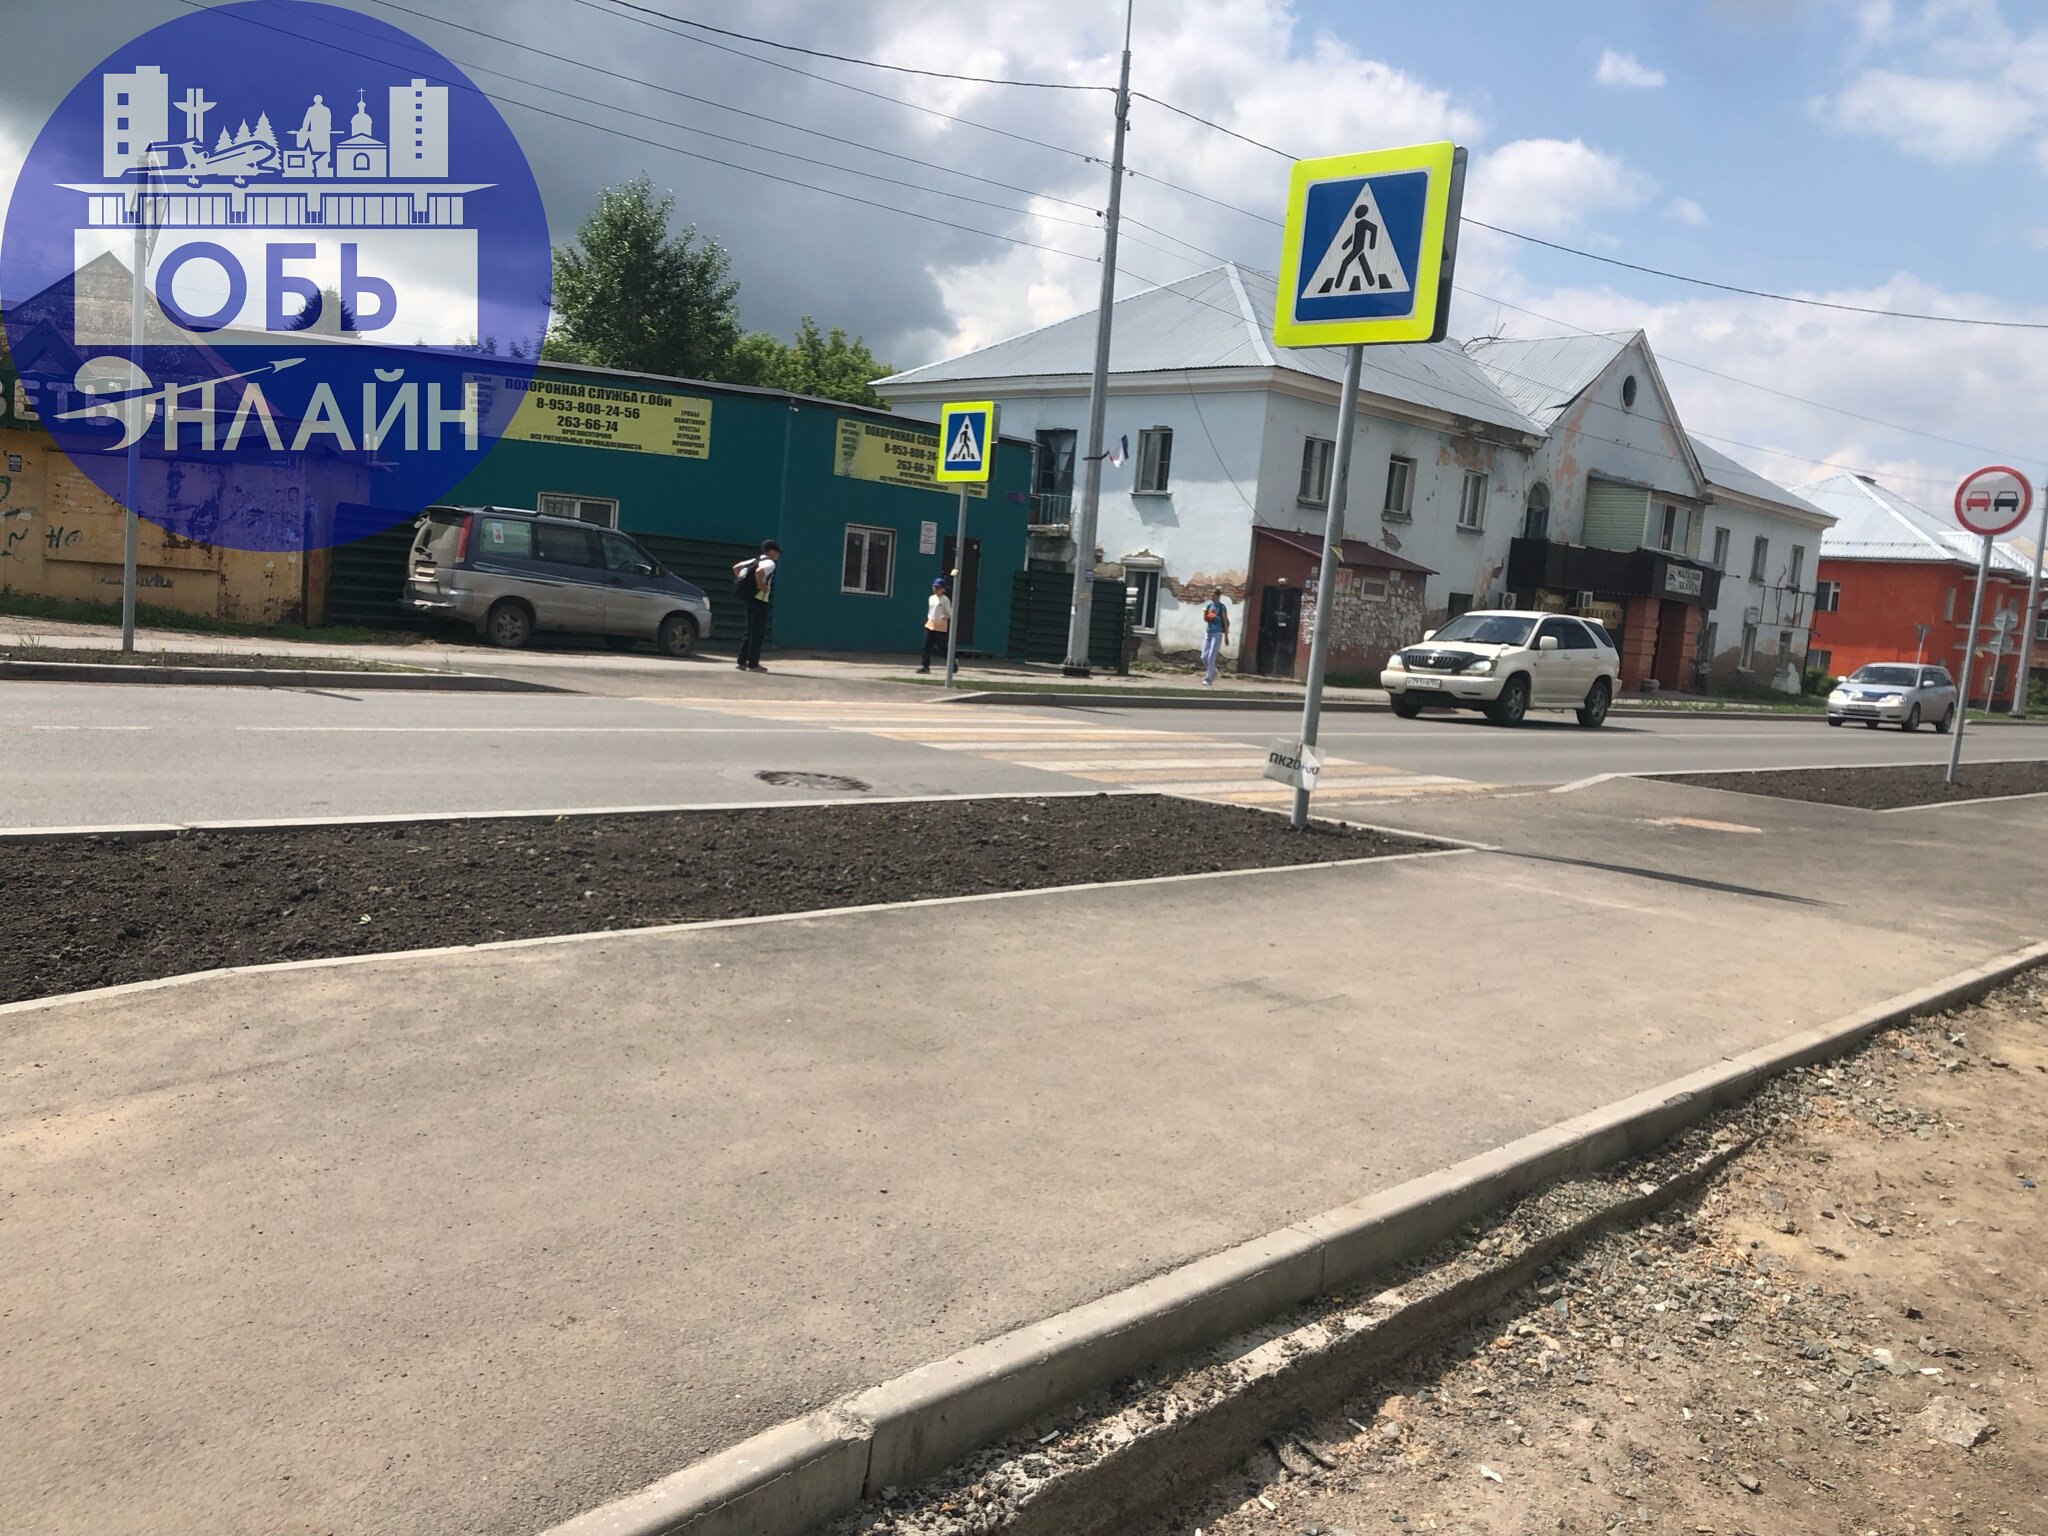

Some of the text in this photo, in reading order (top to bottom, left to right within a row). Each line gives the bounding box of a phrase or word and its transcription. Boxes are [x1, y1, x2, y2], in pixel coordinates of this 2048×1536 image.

[504, 378, 586, 398] ПОХОРОННАЯ
[587, 388, 639, 405] СЛУЖБА
[535, 397, 641, 419] 8-953-808-24-56
[556, 415, 619, 433] 263-66-74
